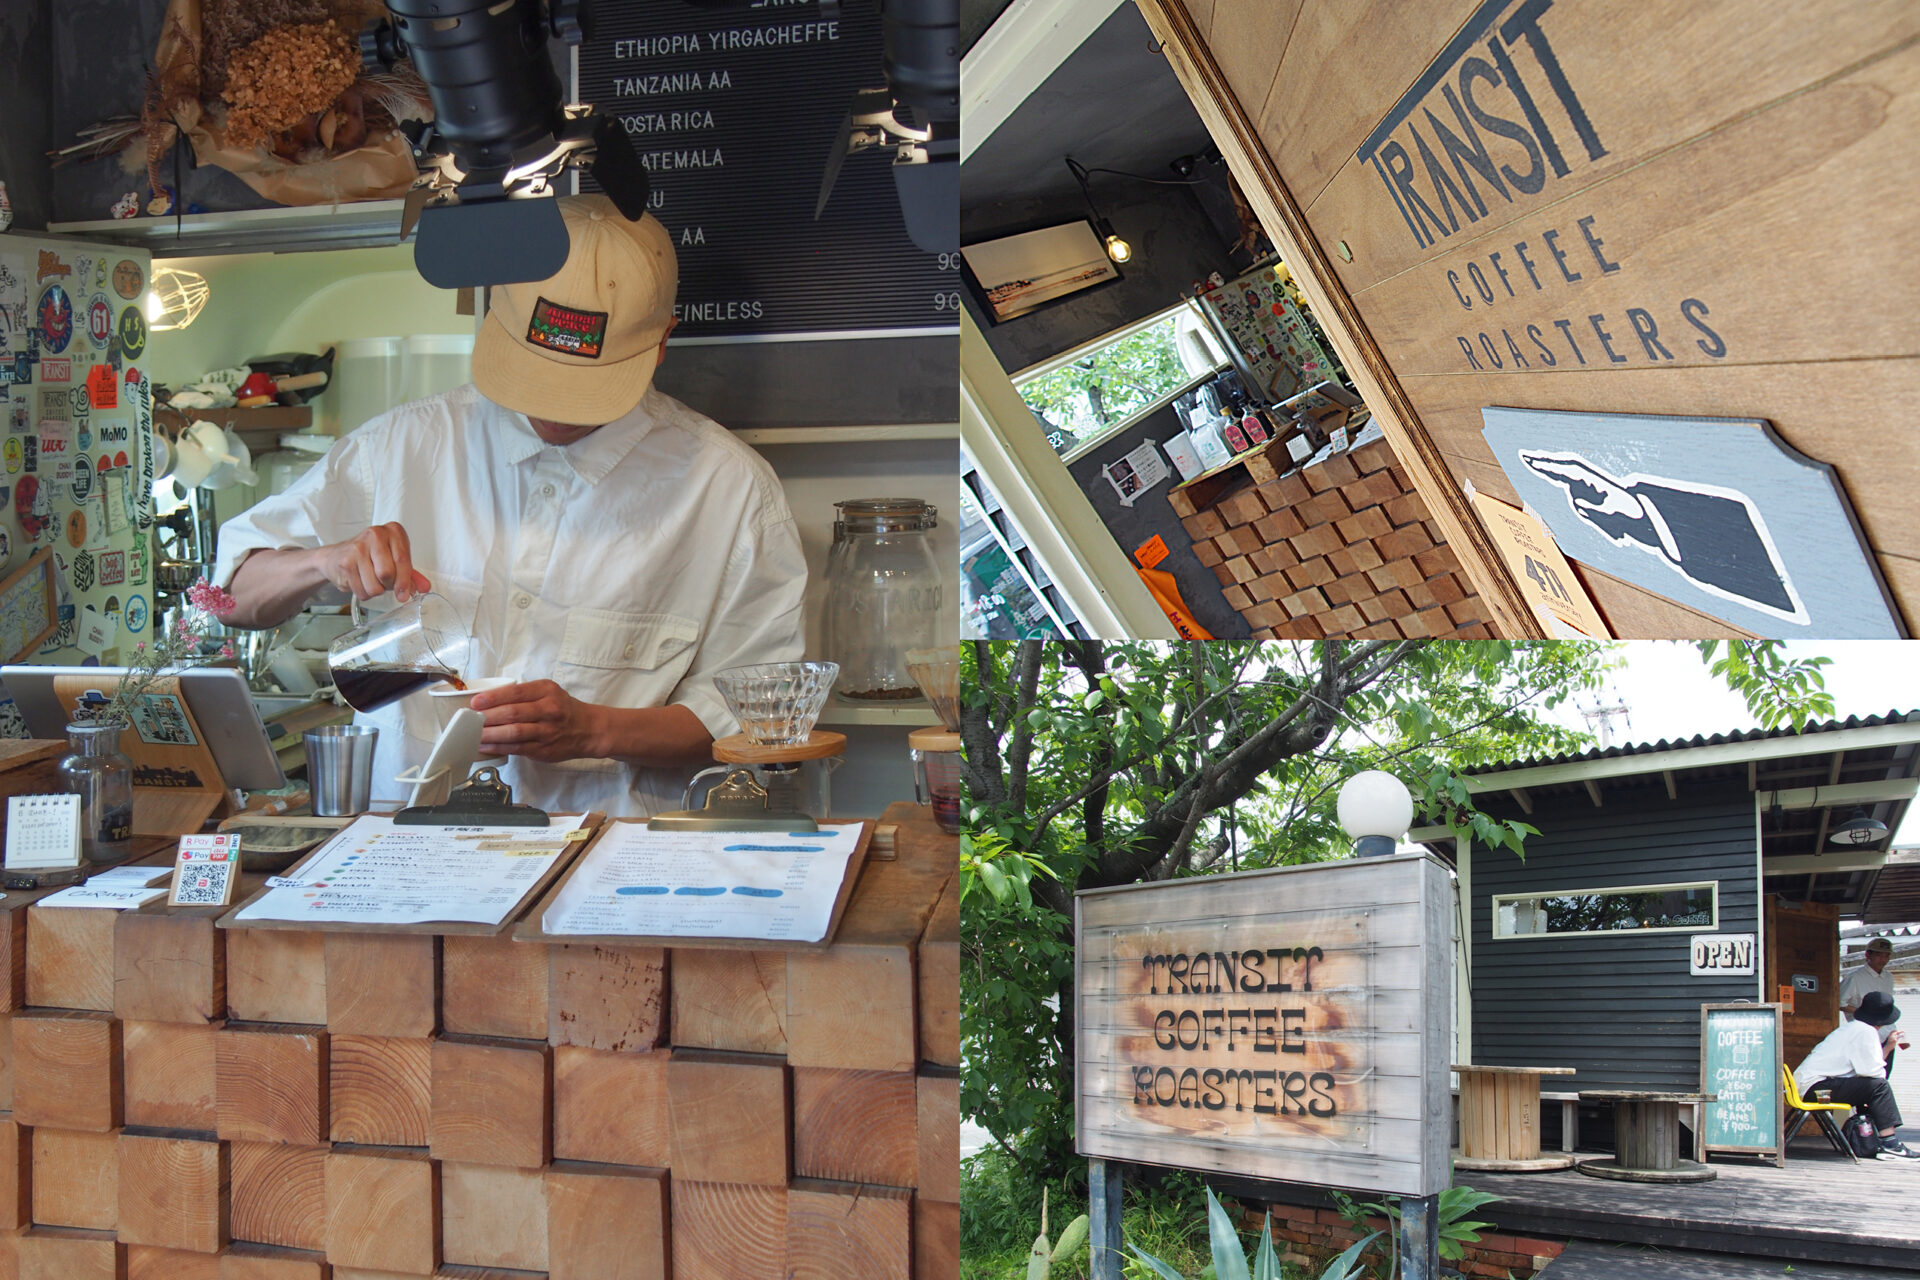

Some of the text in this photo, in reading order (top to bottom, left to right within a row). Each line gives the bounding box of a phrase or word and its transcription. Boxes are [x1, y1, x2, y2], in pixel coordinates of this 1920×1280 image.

[614, 21, 840, 60] ETHIOPIA YIRGACHEFFE
[612, 70, 732, 98] TANZANIA AA
[671, 110, 715, 132] RICA
[1356, 0, 1611, 250] TRANSIT
[639, 148, 725, 172] ATEMALA
[1446, 214, 1622, 311] COFFEE
[92, 308, 107, 334] 61
[1456, 297, 1727, 372] ROASTERS
[111, 825, 131, 840] TR
[1693, 940, 1751, 969] OPEN
[1142, 945, 1325, 995] TRANSIT
[1153, 1006, 1307, 1056] COFFEE
[1717, 1029, 1764, 1047] COFFEE
[1715, 1067, 1757, 1081] COFFEE
[1131, 1064, 1337, 1118] ROASTERS
